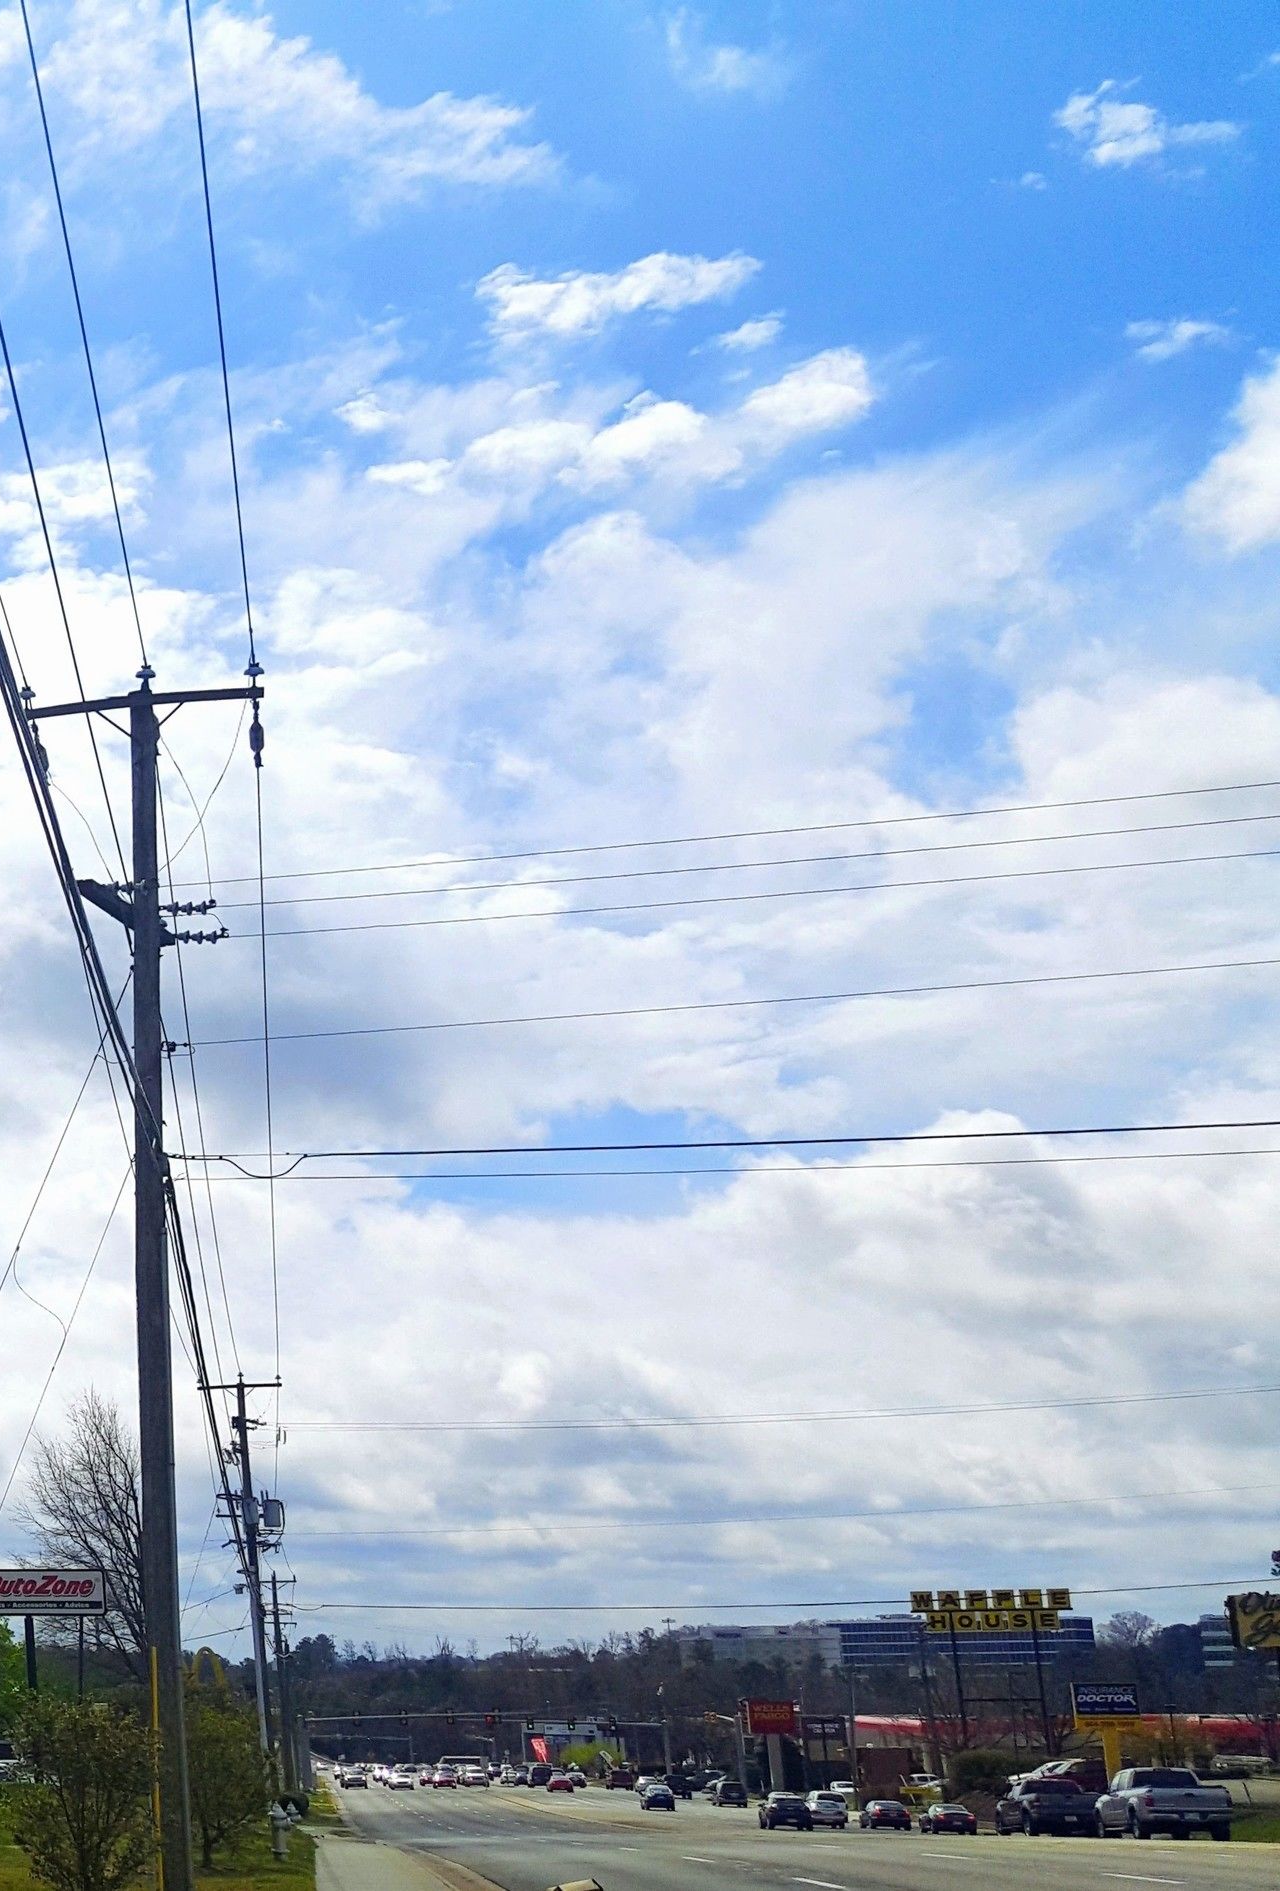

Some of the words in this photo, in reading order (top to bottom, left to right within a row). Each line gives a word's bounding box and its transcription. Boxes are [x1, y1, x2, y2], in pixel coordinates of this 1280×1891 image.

[912, 1589, 1069, 1609] WAFFLE
[928, 1612, 1058, 1629] HOUSE
[1079, 1686, 1135, 1694] INSURANCE
[1077, 1694, 1136, 1706] DOCTOR
[754, 1712, 790, 1720] FARGO
